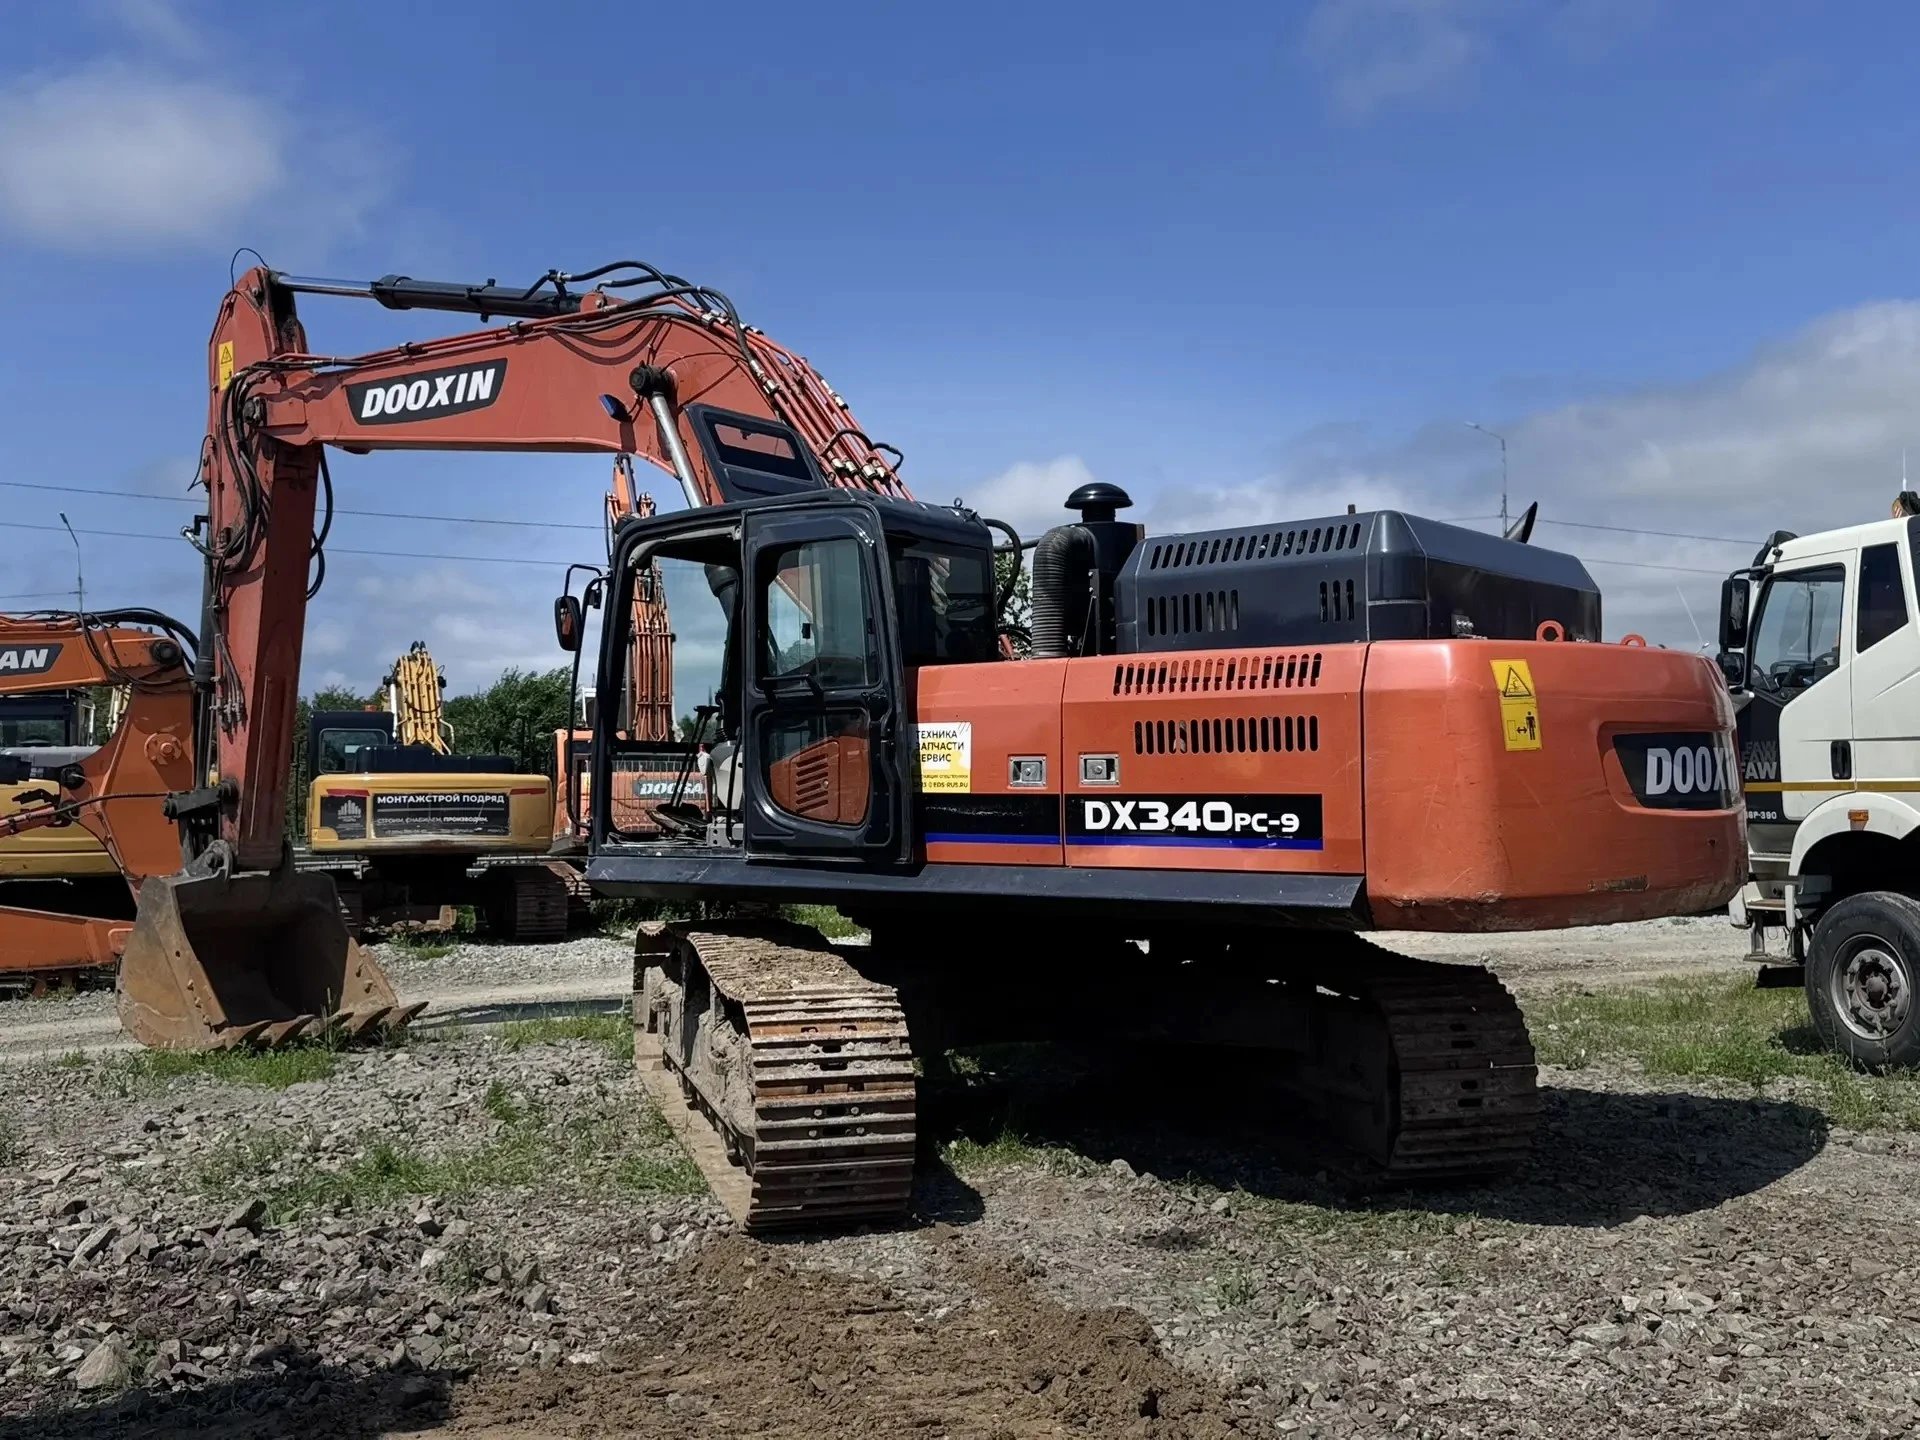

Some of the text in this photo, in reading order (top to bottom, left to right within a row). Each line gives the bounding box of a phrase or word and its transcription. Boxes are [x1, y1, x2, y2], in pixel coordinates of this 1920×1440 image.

[361, 368, 496, 418] DOOXIN
[917, 730, 957, 739] ТЕХНИКА
[640, 783, 707, 794] DOOSA
[377, 794, 505, 804] МОНТАЖСТРОЙ ПОДРЯД
